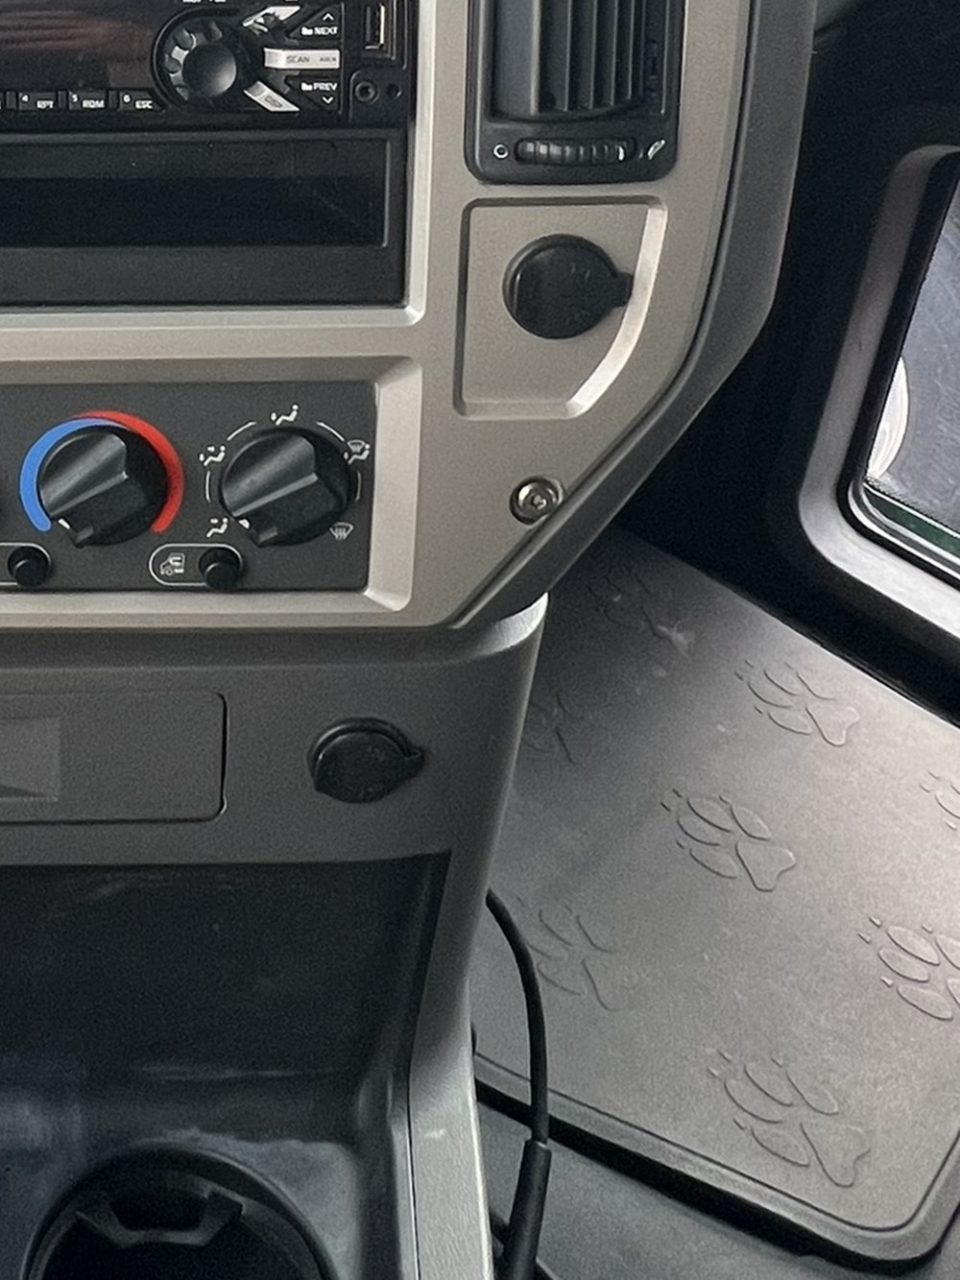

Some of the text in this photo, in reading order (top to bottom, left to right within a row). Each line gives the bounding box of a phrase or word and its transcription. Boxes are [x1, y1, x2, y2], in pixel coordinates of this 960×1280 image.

[314, 26, 338, 35] NEXT
[286, 55, 310, 64] SCAN
[313, 82, 338, 91] PREV
